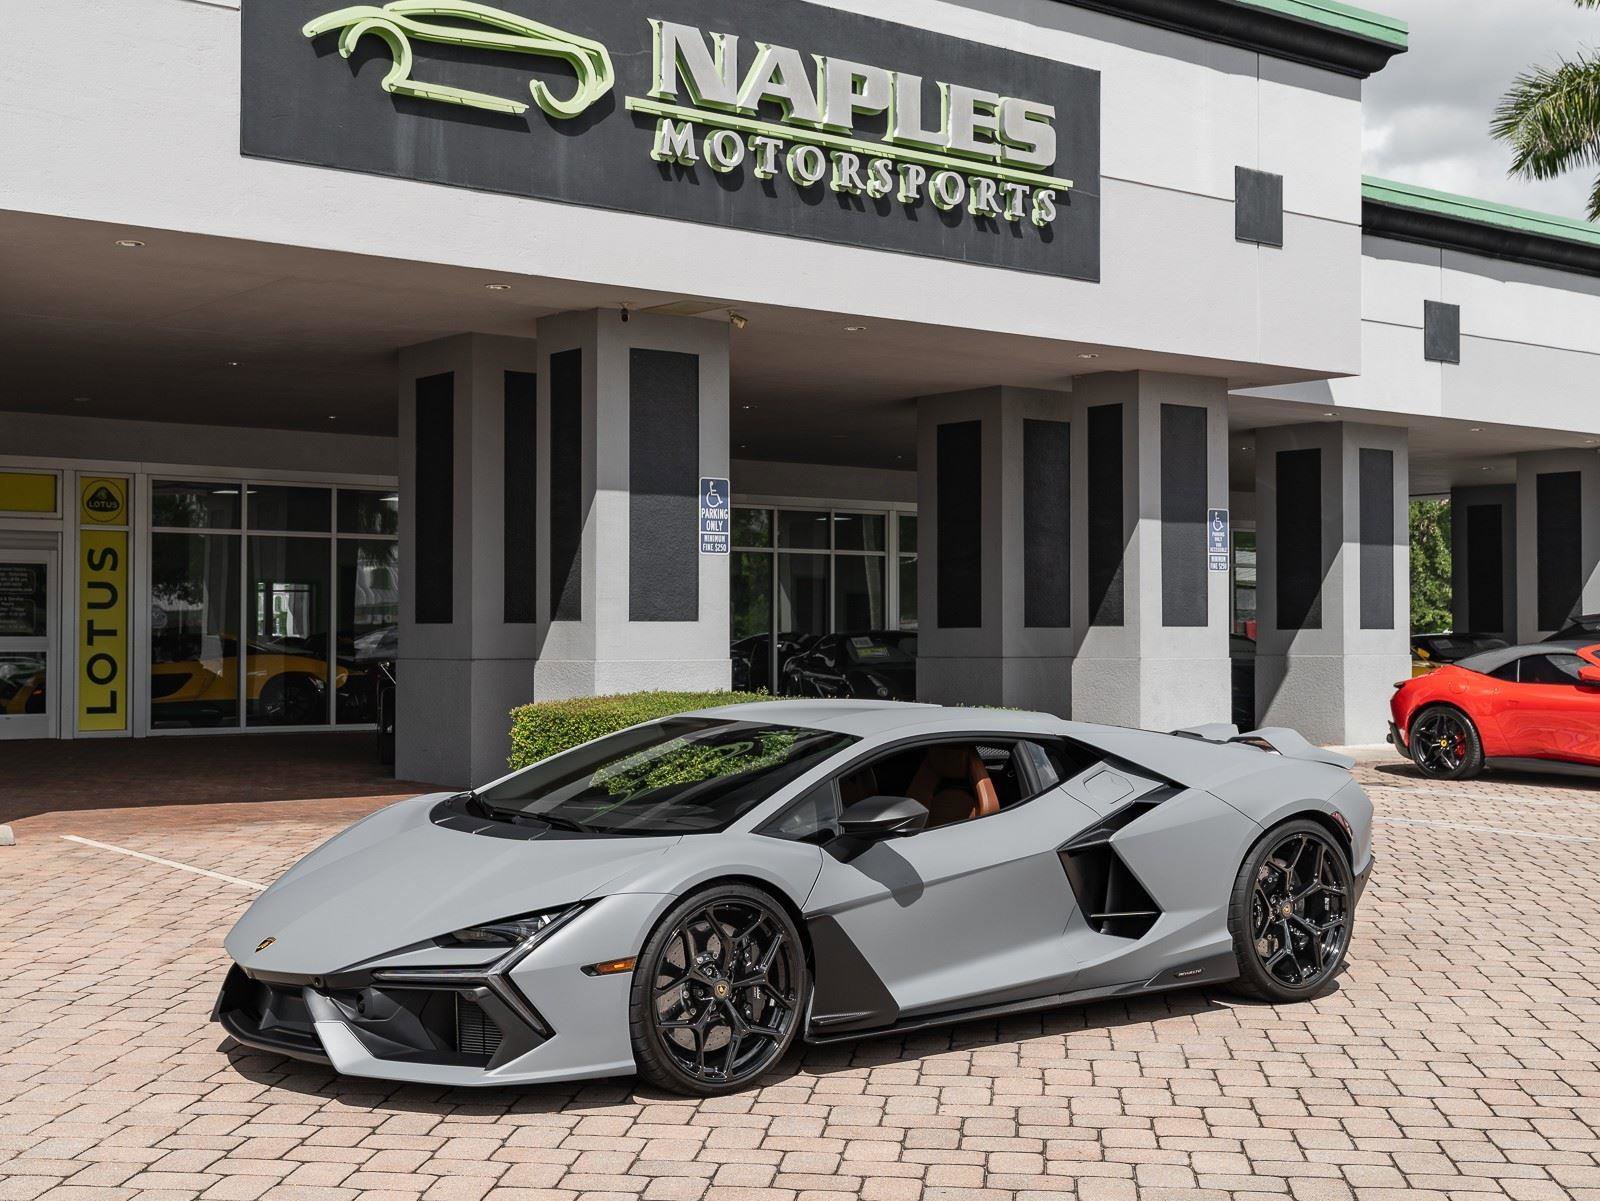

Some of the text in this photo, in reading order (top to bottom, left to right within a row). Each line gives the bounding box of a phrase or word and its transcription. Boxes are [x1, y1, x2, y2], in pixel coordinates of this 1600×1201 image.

[647, 17, 1056, 168] NAPLES
[650, 118, 1056, 226] MOTORSPORTS
[89, 500, 118, 508] LOTUS
[701, 508, 728, 519] PARKING
[706, 520, 723, 531] ONLY
[704, 534, 726, 542] MINIMUM
[702, 543, 727, 552] FINE $250
[86, 547, 118, 714] LOTUS
